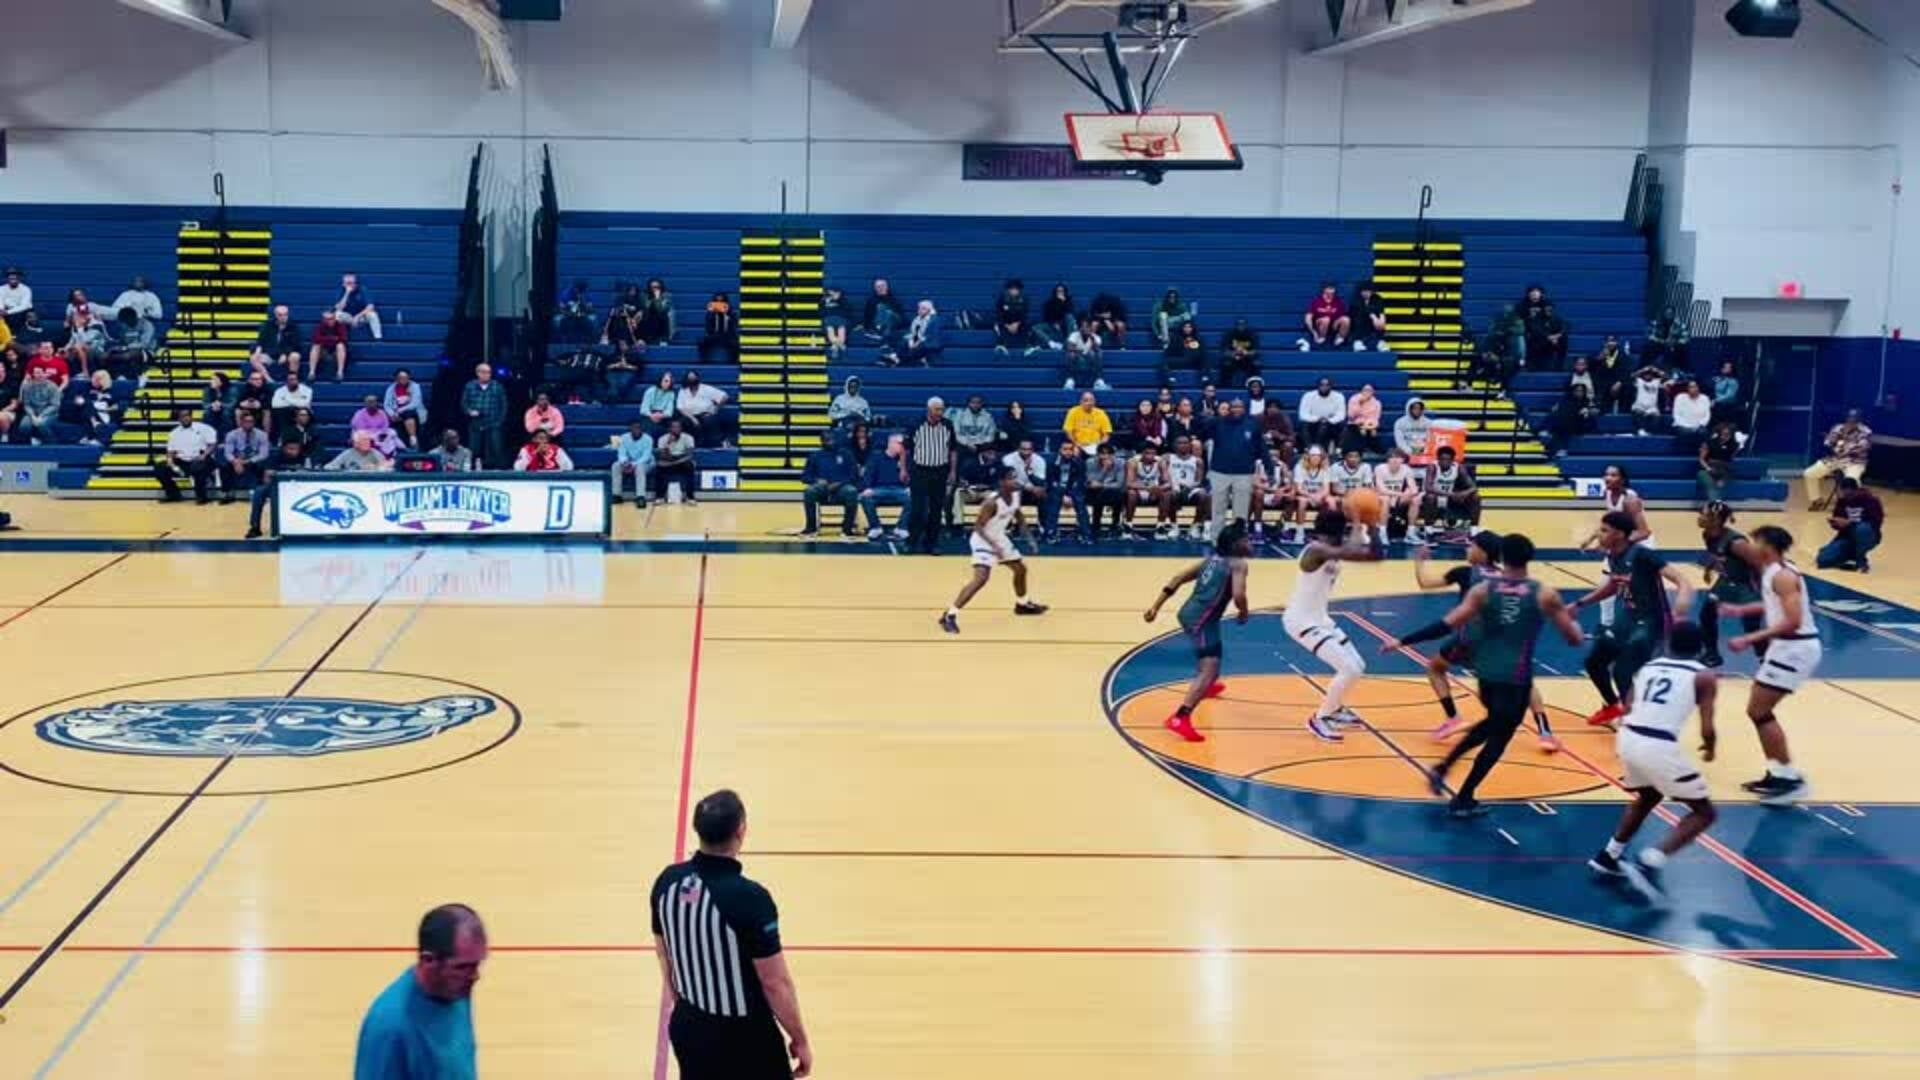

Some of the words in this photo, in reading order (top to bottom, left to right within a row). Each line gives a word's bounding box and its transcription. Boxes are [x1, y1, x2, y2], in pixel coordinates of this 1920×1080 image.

[383, 486, 443, 515] WILLIAM
[459, 486, 510, 516] DWYER
[544, 486, 575, 530] D
[1643, 677, 1672, 704] 12
